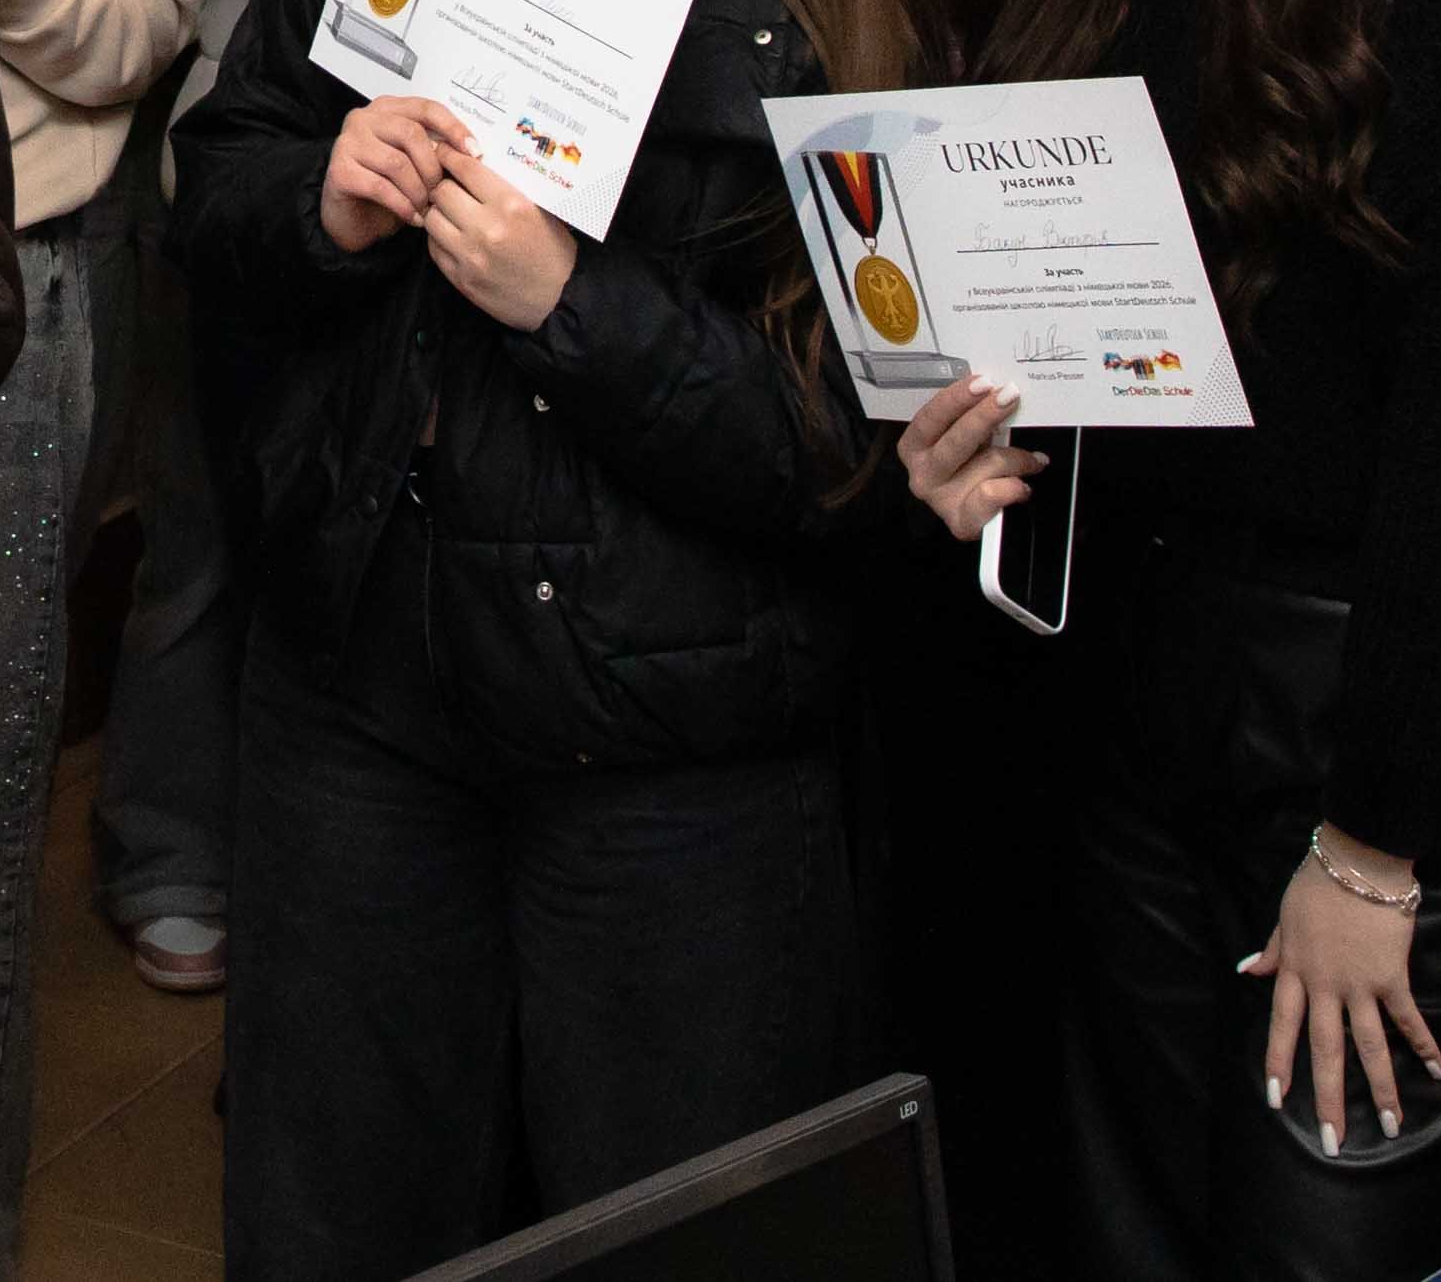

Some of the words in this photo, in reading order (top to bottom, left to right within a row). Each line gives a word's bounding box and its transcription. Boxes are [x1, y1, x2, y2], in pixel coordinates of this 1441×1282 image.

[940, 134, 1112, 173] URKUNDE
[547, 170, 572, 191] Schule
[999, 175, 1074, 193] учасника
[1003, 195, 1083, 208] НАГОРОДЖУЄТЬСЯ
[1055, 268, 1084, 278] участь
[1112, 295, 1167, 306] StartDeutsch
[1167, 294, 1195, 305] Schule
[1112, 386, 1161, 397] DerDieDas
[1162, 385, 1191, 396] Schule
[899, 1100, 919, 1120] LED
